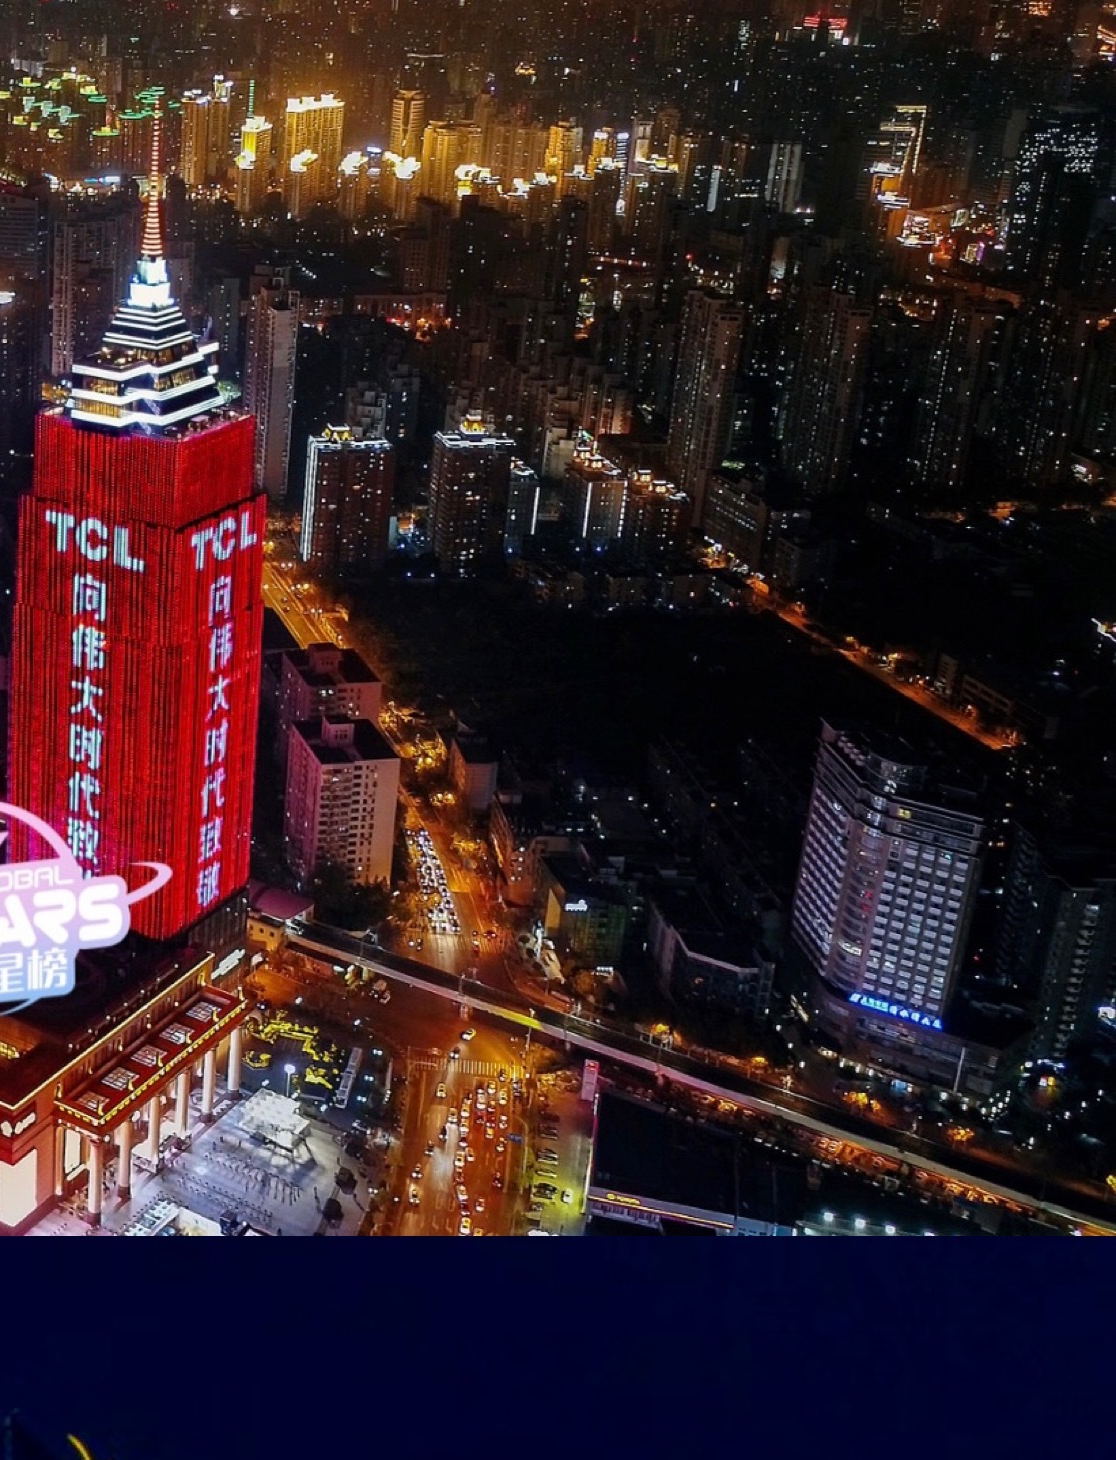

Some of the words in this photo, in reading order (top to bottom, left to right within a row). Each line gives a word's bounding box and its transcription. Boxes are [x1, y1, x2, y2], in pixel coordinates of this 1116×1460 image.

[46, 510, 145, 573] TCL
[191, 512, 257, 570] TCL
[68, 574, 108, 880] 向伟大时代致
